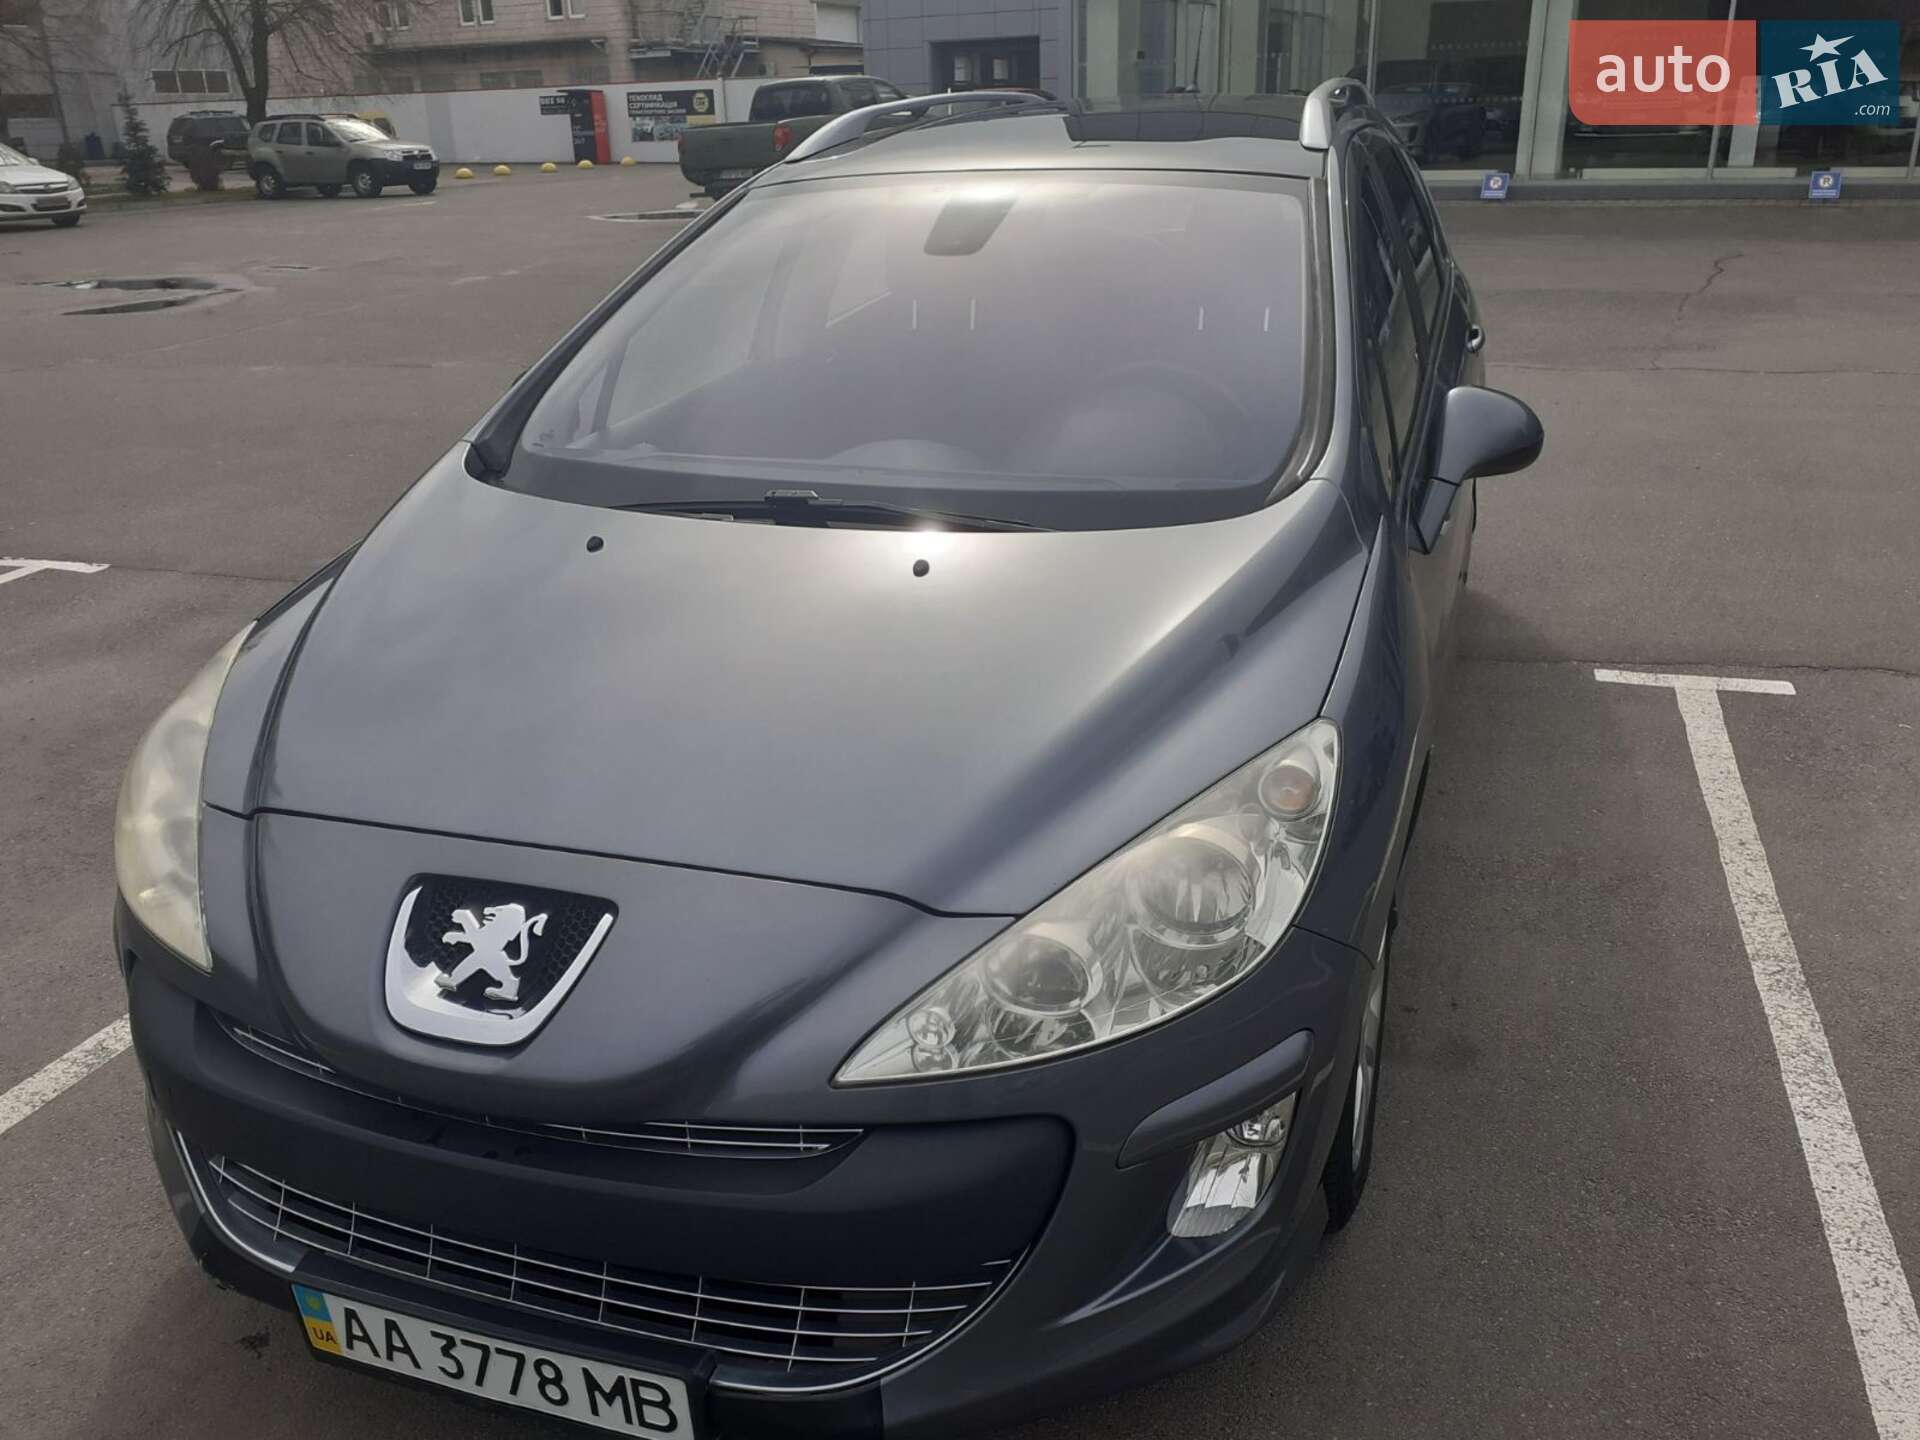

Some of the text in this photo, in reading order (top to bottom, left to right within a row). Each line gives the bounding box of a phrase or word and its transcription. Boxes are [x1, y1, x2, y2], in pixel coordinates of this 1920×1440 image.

[311, 1326, 338, 1345] UA
[343, 1306, 679, 1434] AA 3778 MB
